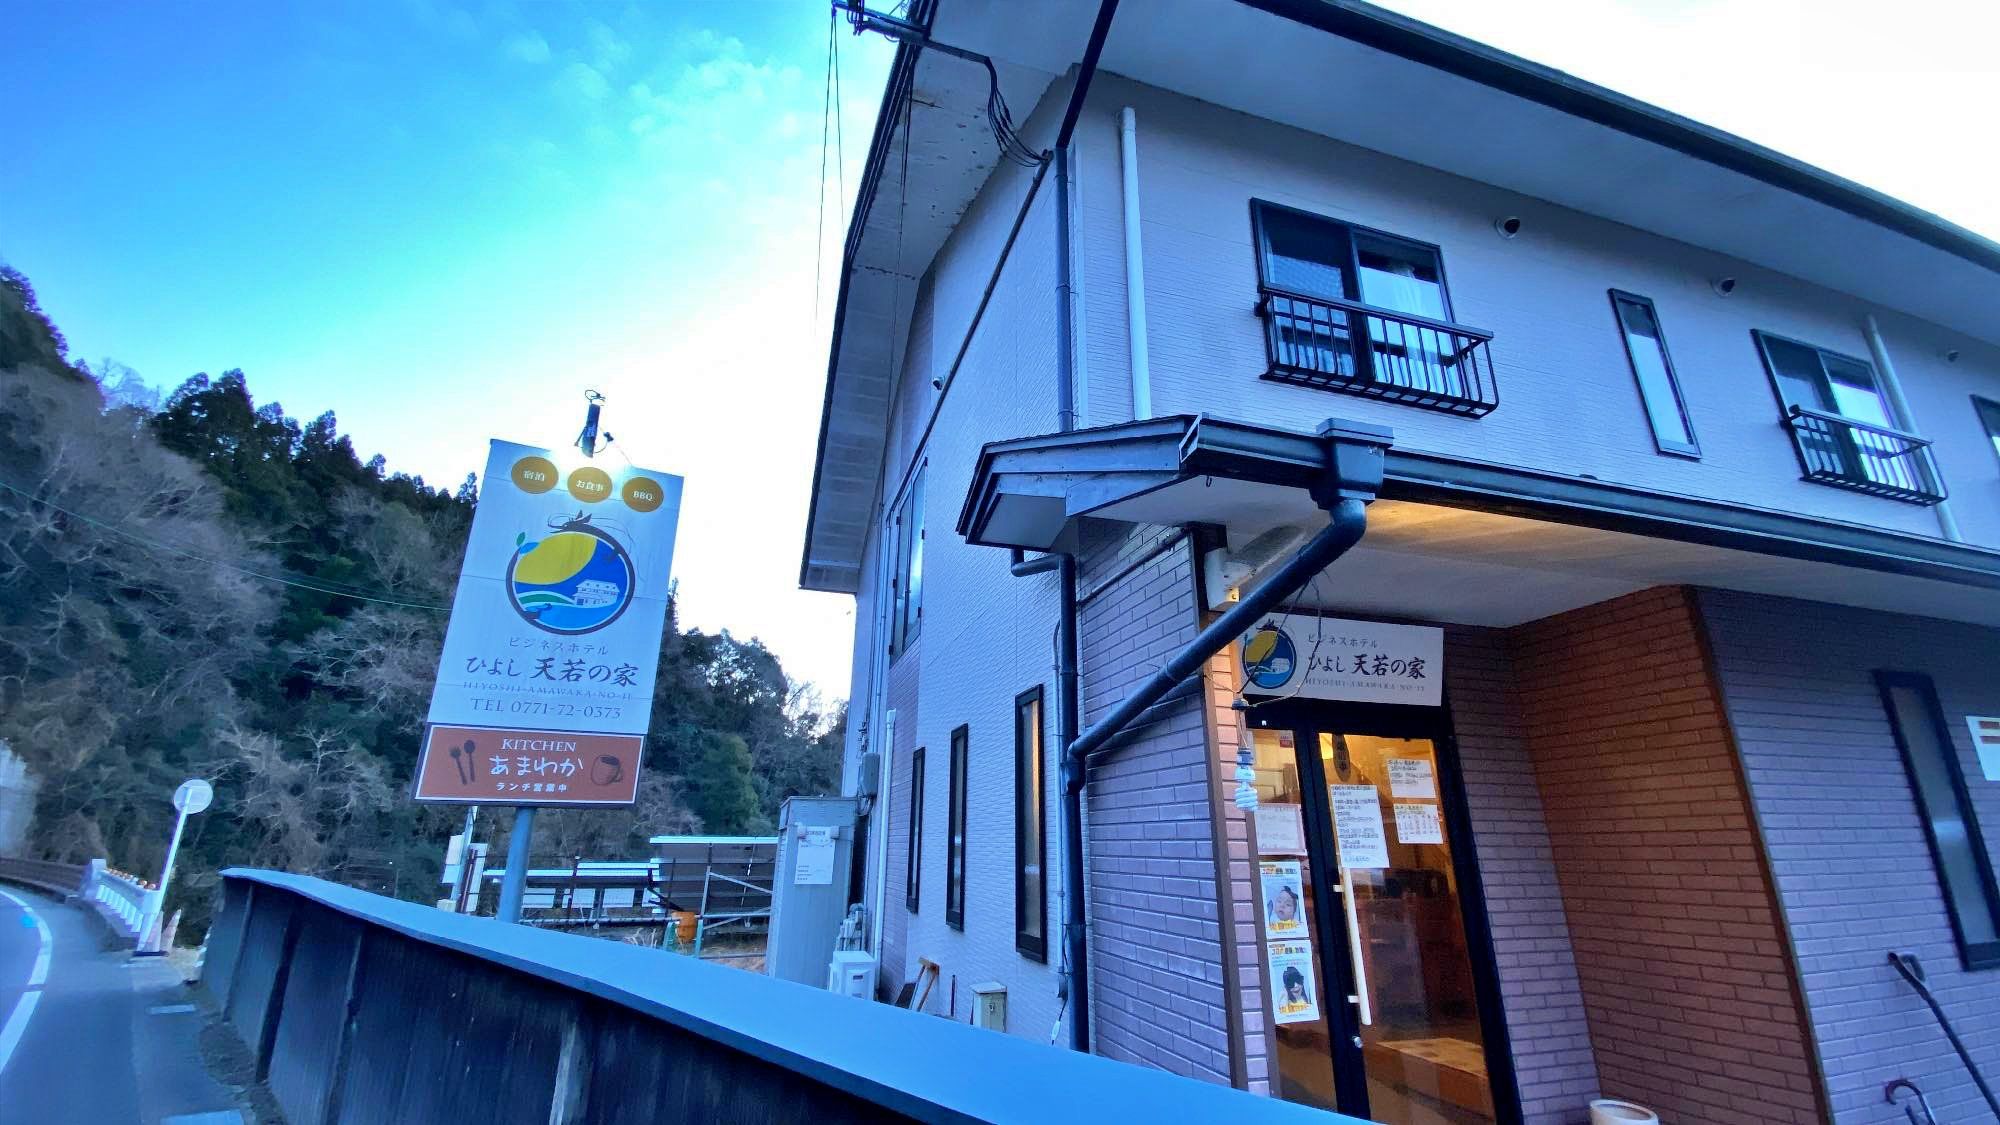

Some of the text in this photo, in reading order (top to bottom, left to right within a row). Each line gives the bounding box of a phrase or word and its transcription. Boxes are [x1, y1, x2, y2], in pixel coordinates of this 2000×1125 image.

[633, 490, 654, 501] BBQ
[509, 636, 609, 656] ビジネスホテル
[466, 656, 640, 687] ひよし 天若の家
[1308, 653, 1427, 680] ひよし 天若の家
[471, 697, 623, 719] TEL 0771-72-0373
[501, 738, 577, 752] KITCHEN
[489, 754, 584, 778] あまわか
